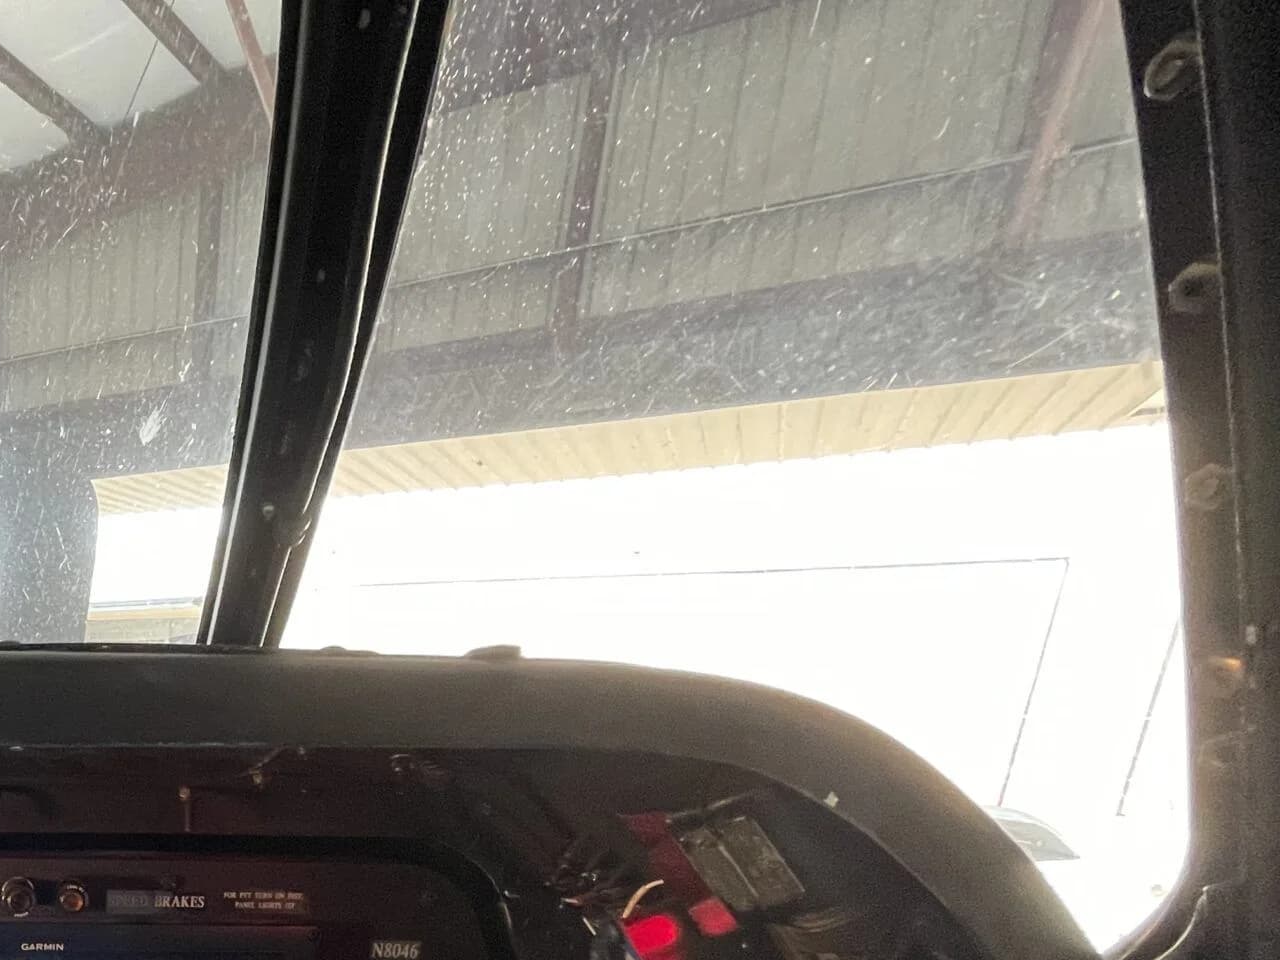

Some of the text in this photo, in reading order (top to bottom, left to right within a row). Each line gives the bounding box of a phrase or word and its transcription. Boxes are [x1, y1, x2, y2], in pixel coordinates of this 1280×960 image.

[154, 895, 206, 909] BRAKES
[20, 943, 65, 951] GARMIN
[371, 942, 421, 960] N8046
